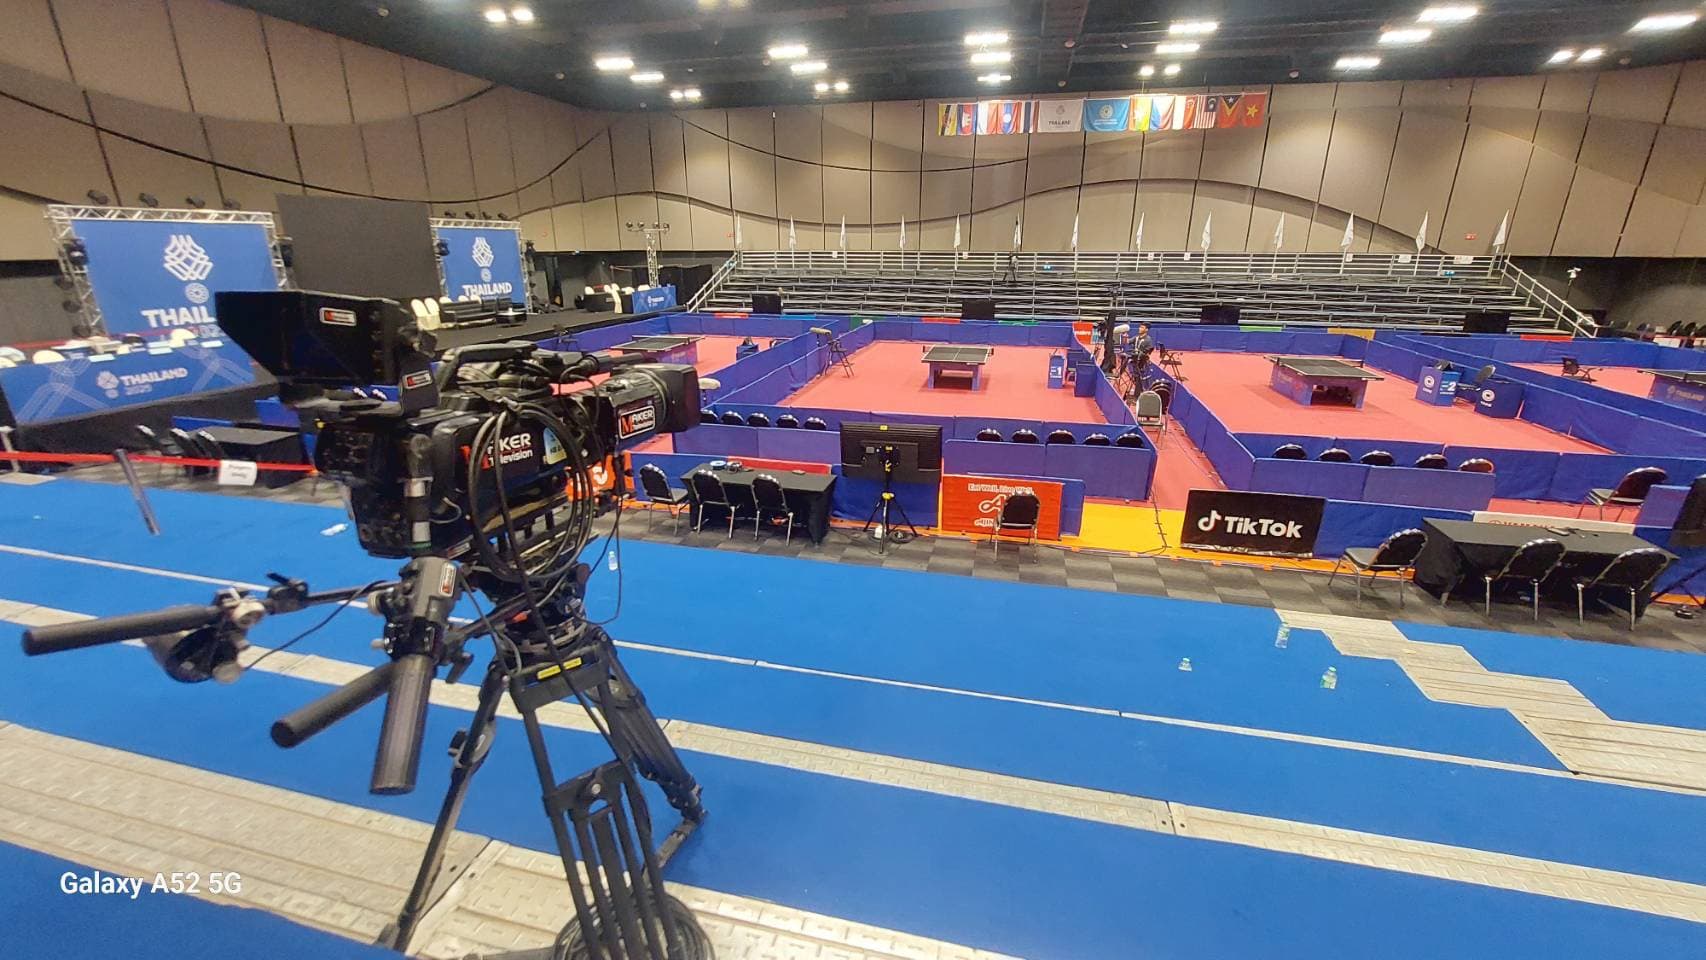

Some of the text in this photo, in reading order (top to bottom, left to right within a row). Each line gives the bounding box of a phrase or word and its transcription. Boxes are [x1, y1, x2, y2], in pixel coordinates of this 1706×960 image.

[462, 282, 513, 296] THAILAND
[140, 305, 217, 328] THAIL
[120, 368, 188, 385] THAILAND
[488, 449, 533, 467] Tlevision
[1224, 516, 1303, 538] TikTok
